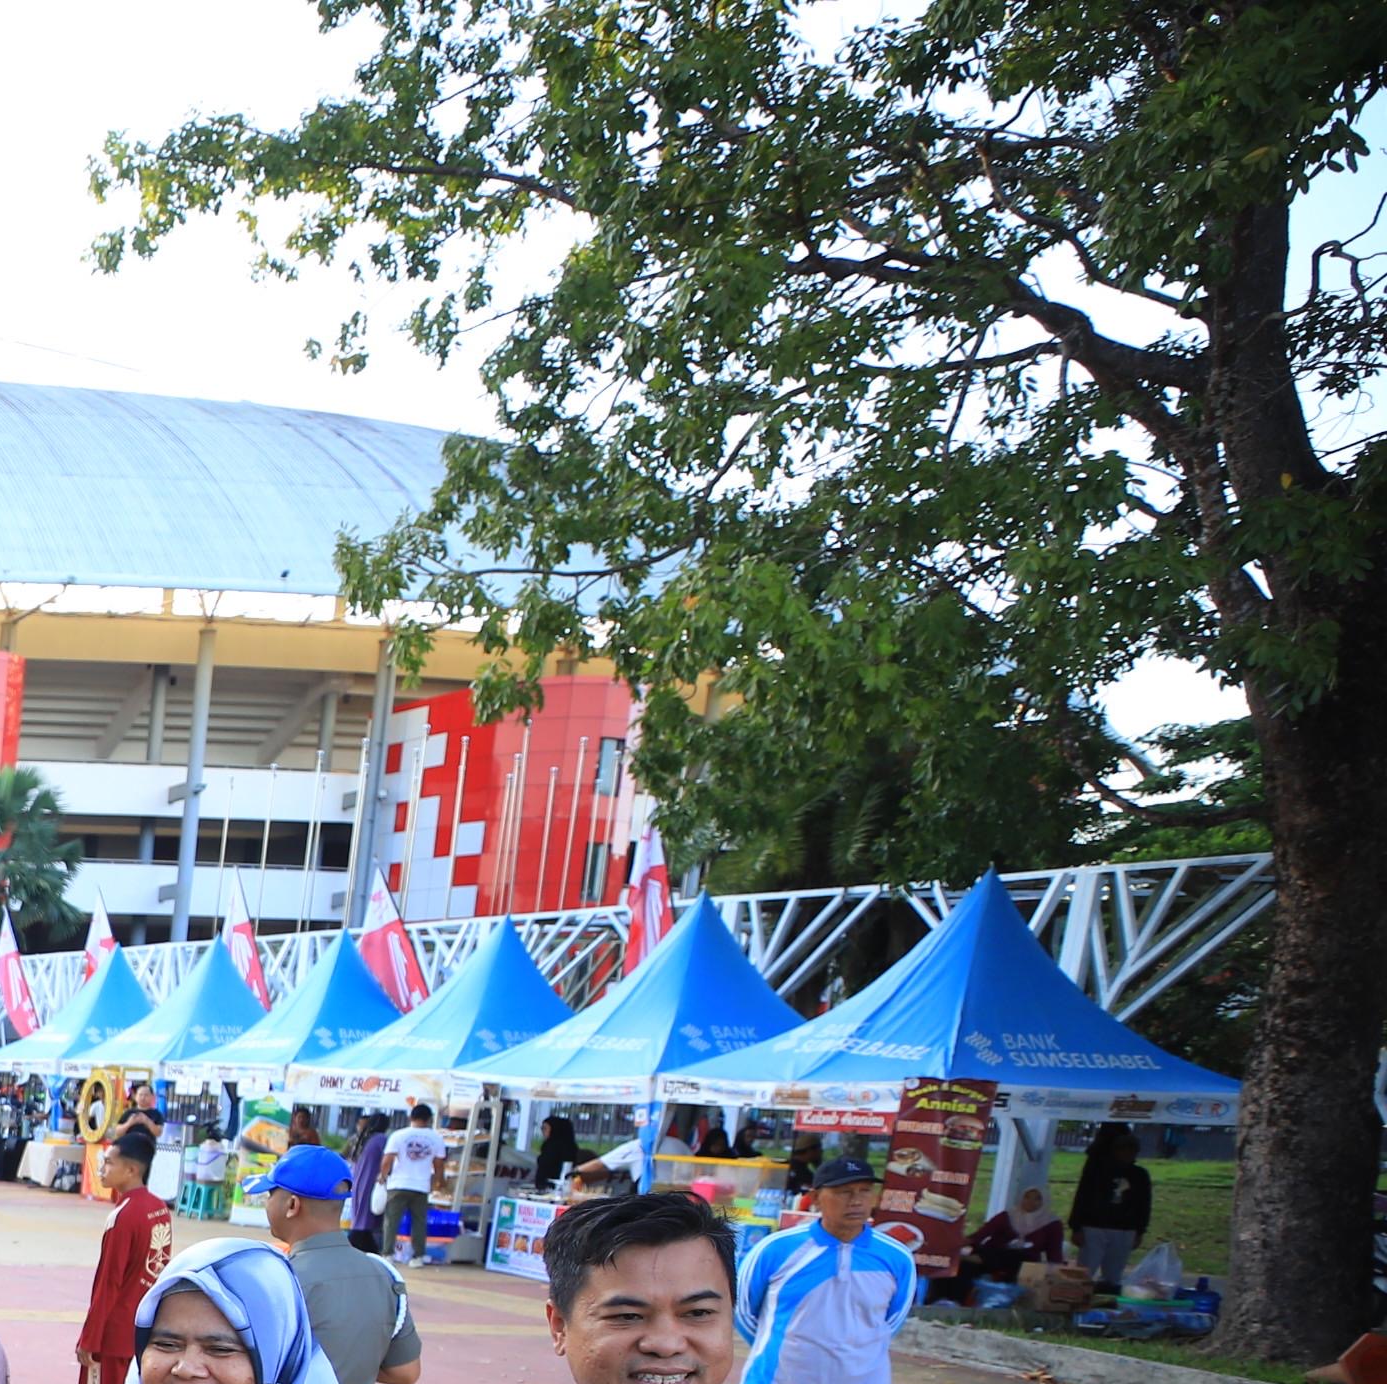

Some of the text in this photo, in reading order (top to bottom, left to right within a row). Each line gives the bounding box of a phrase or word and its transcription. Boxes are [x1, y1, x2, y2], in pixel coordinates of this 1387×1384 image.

[711, 1025, 759, 1040] BANK
[1002, 1033, 1060, 1050] BANK
[1009, 1051, 1162, 1070] SUMSELBABEL
[916, 1098, 978, 1113] Annisa
